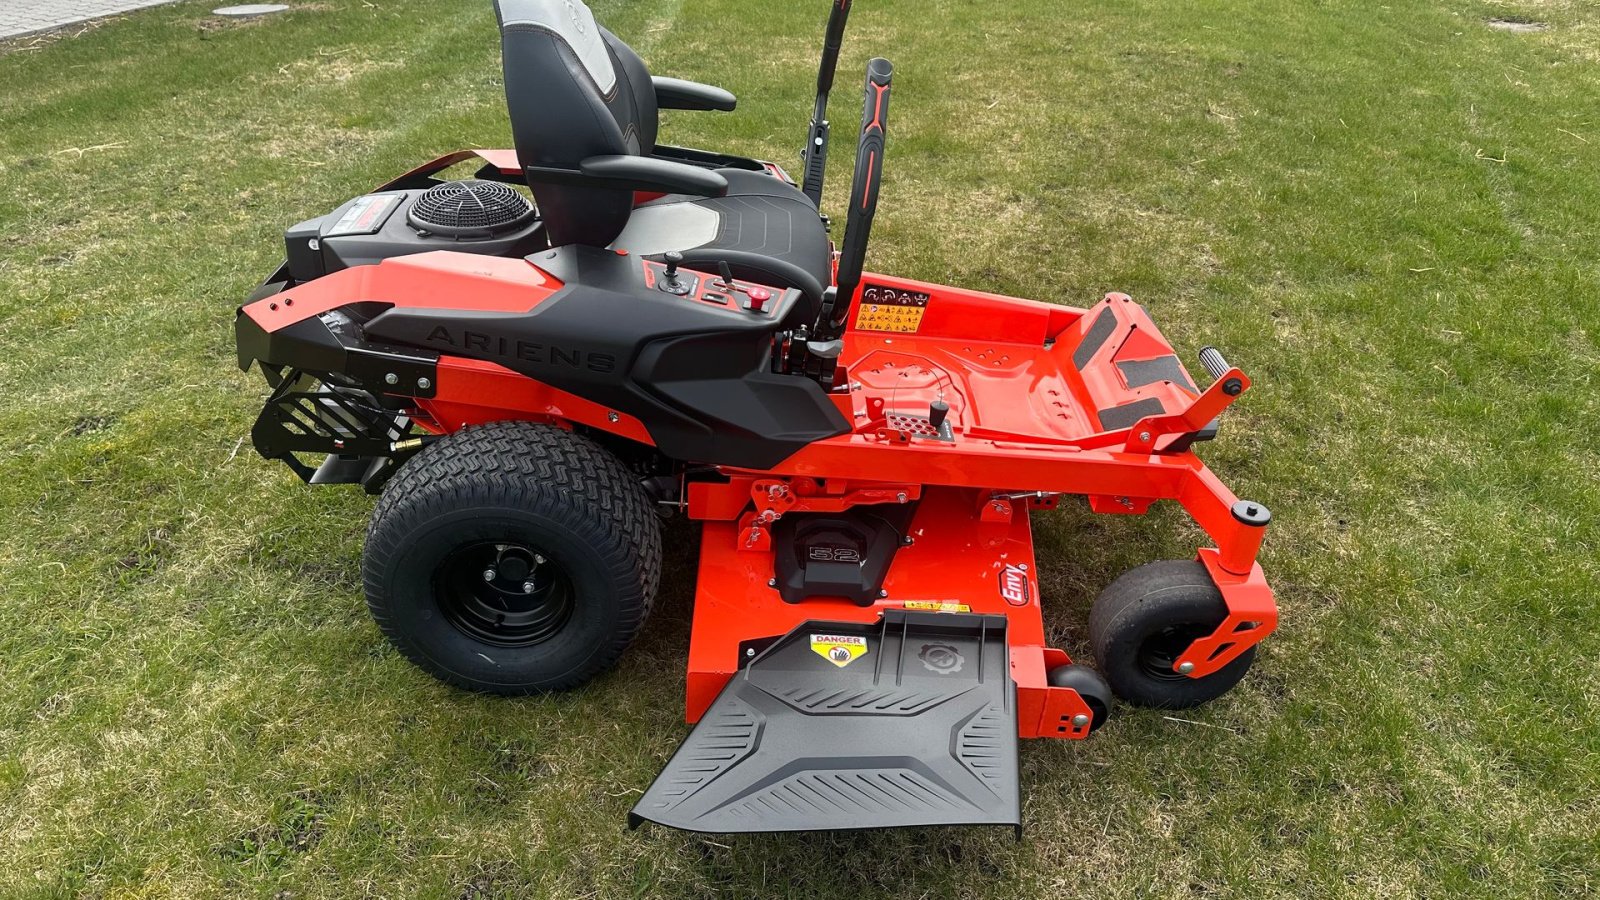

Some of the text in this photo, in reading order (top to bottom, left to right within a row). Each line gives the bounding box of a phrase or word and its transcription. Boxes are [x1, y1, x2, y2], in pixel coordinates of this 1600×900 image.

[426, 325, 615, 373] ARIENS
[809, 546, 859, 562] 52
[816, 635, 861, 644] DANGER
